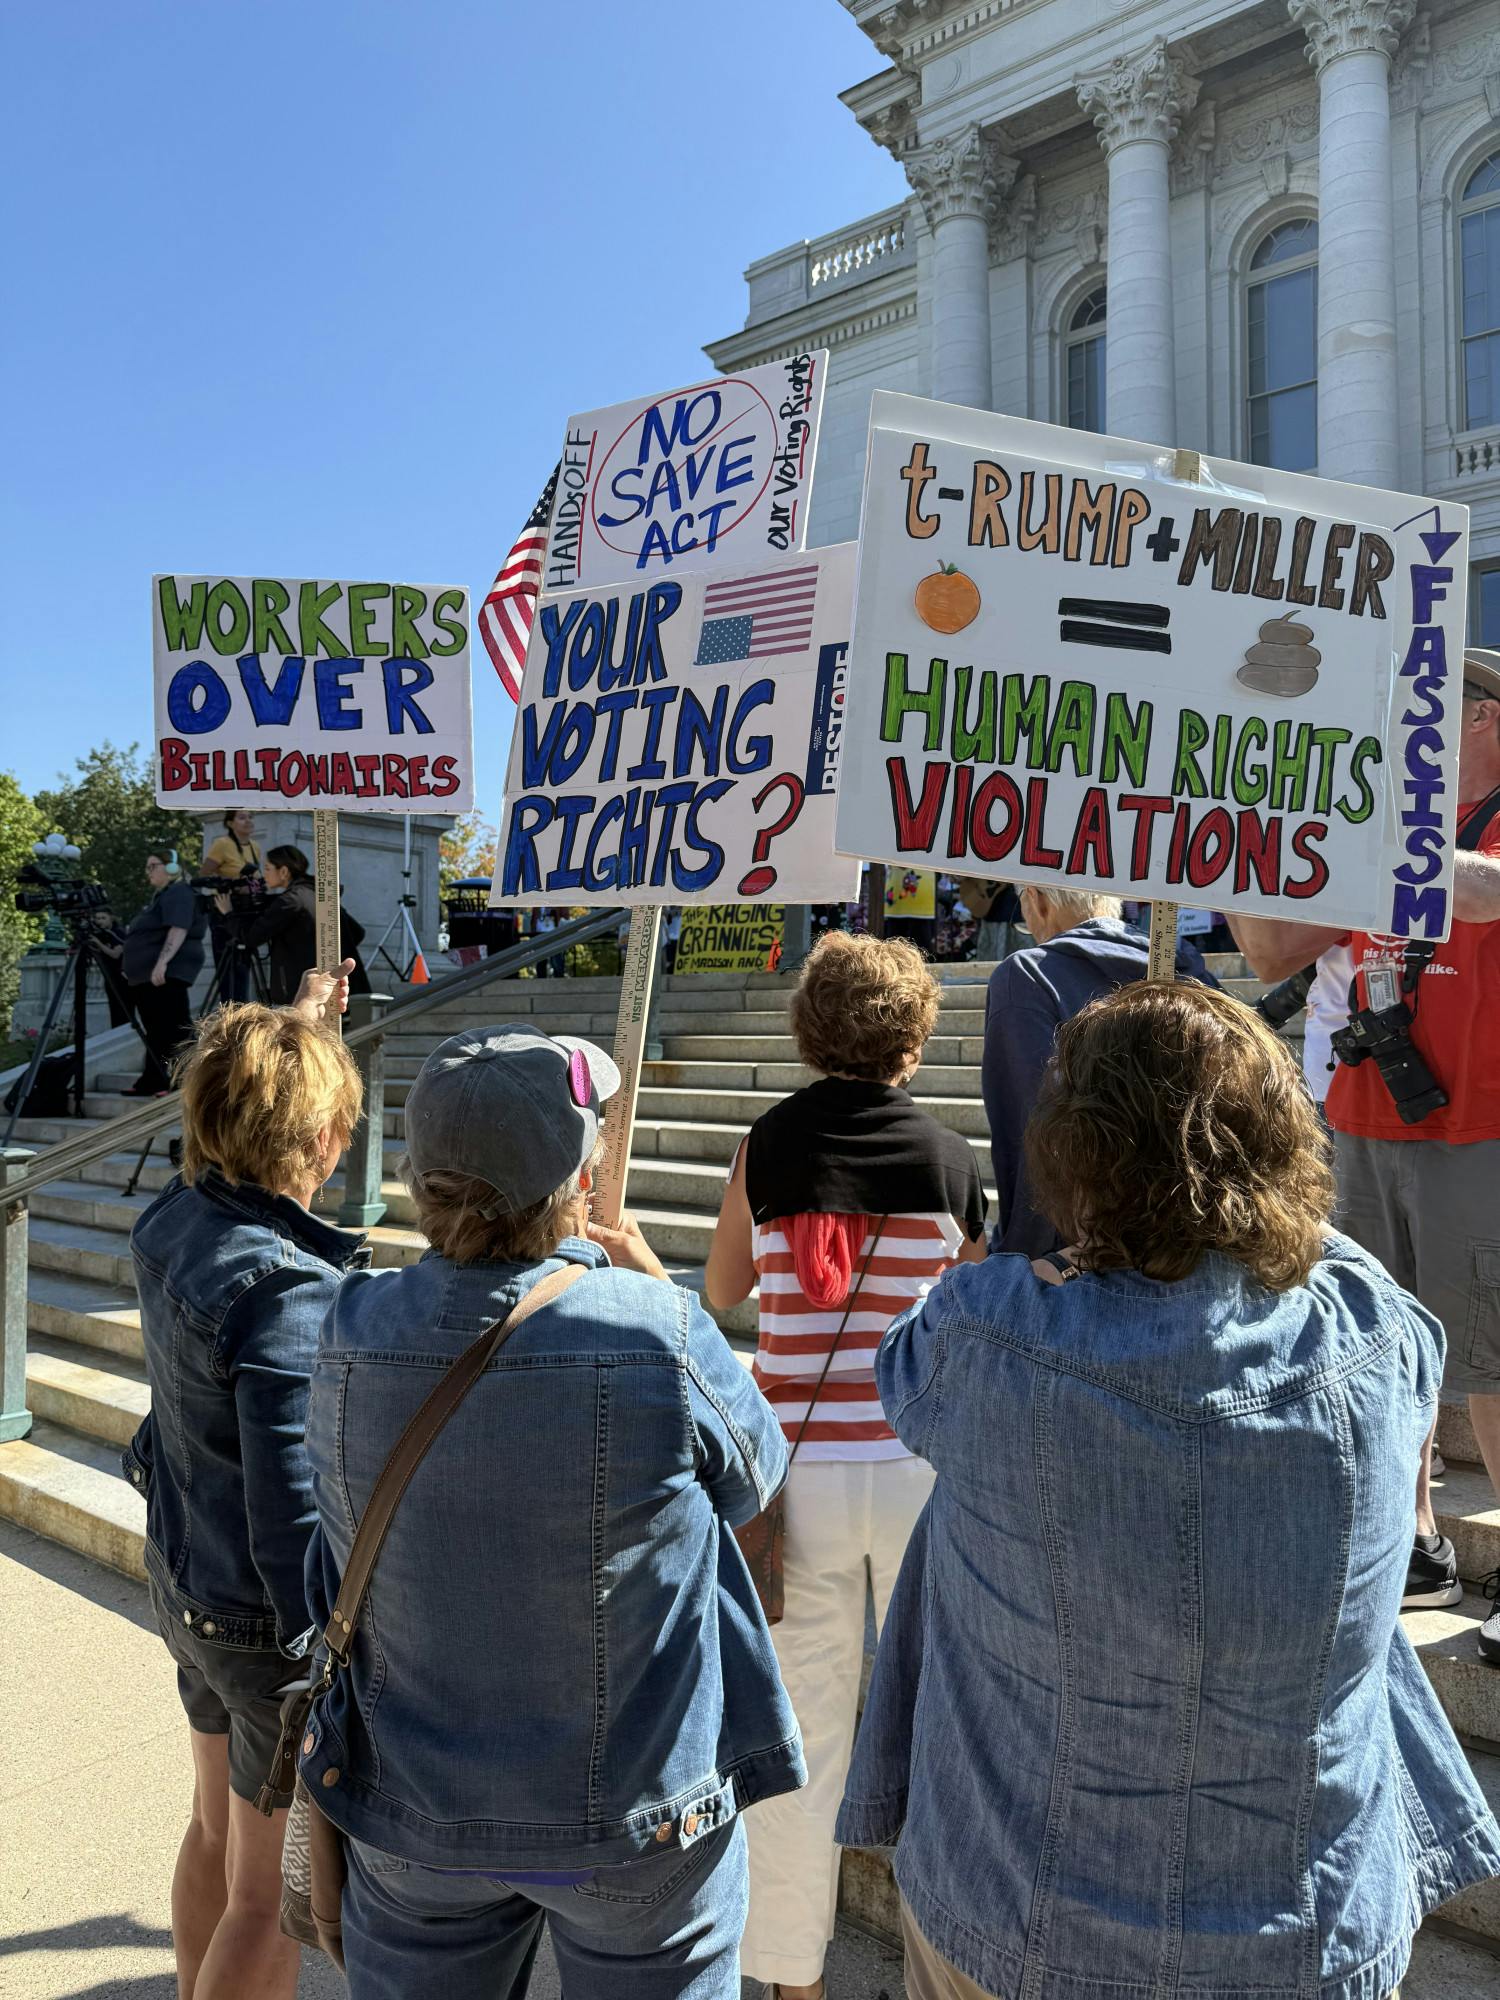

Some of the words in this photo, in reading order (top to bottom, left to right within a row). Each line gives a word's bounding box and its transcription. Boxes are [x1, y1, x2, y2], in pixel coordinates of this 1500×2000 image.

[779, 354, 813, 420] Rights
[638, 391, 722, 467] NO
[773, 419, 811, 496] Voting
[597, 435, 757, 528] SAVE
[636, 500, 737, 569] ACT
[1177, 508, 1395, 619] MILLER
[159, 576, 468, 660] WORKERS
[540, 581, 683, 699] YOUR
[167, 652, 435, 734] OVER
[159, 738, 461, 798] BILLIONAIRES
[522, 678, 776, 790] VOTING
[880, 652, 1154, 788] HUMAN
[1171, 708, 1383, 824] RIGHTS
[1392, 564, 1454, 938] FASCISM
[886, 757, 1330, 899] VIOLATIONS
[678, 925, 777, 955] GRANNIES
[707, 903, 785, 925] RAGING
[1153, 929, 1163, 950] Shop
[632, 995, 643, 1023] VISIT
[618, 1105, 628, 1131] Service
